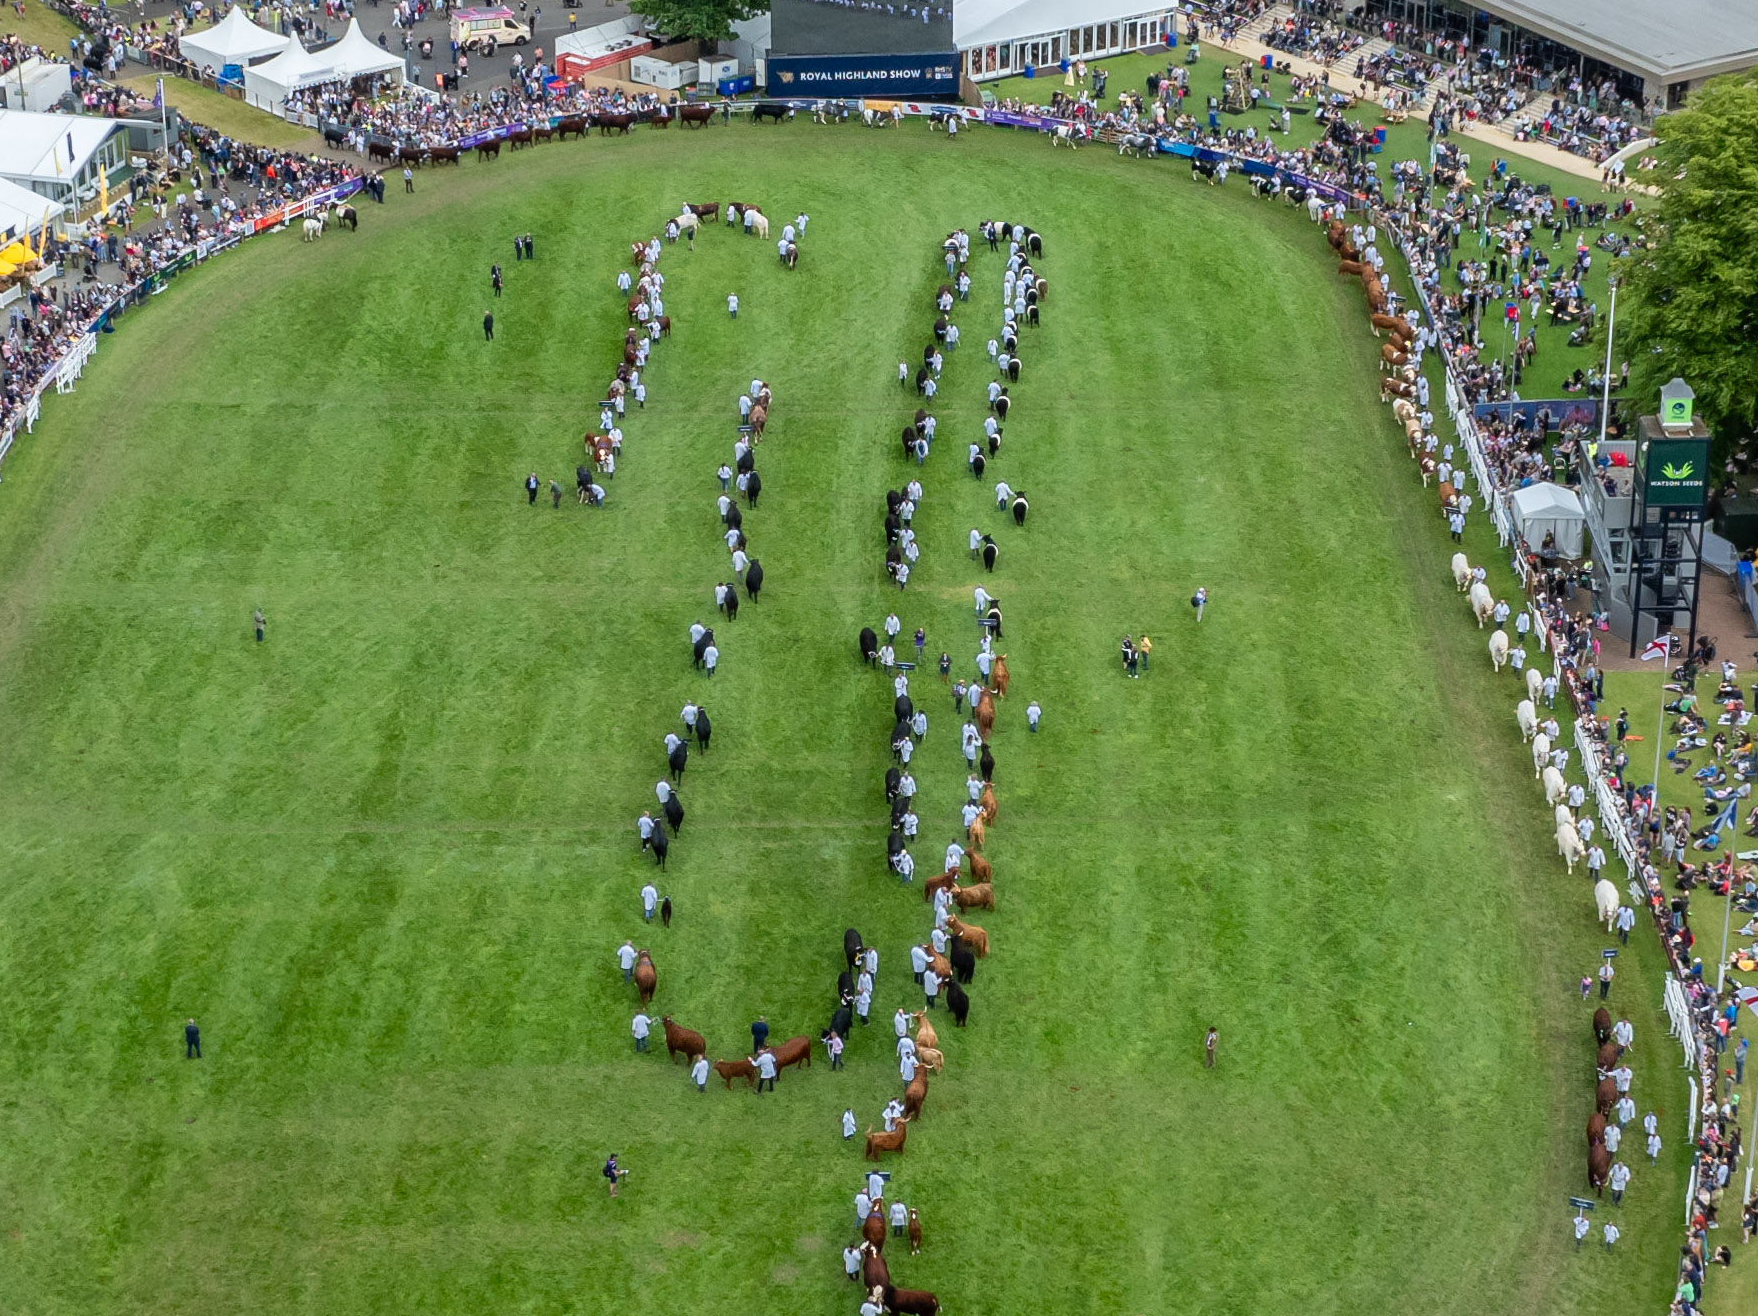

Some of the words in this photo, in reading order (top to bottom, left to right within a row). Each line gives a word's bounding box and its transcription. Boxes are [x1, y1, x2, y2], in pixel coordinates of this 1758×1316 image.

[800, 72, 833, 81] ROYAL
[834, 70, 888, 81] HIGHLAND
[889, 69, 921, 79] SHOW
